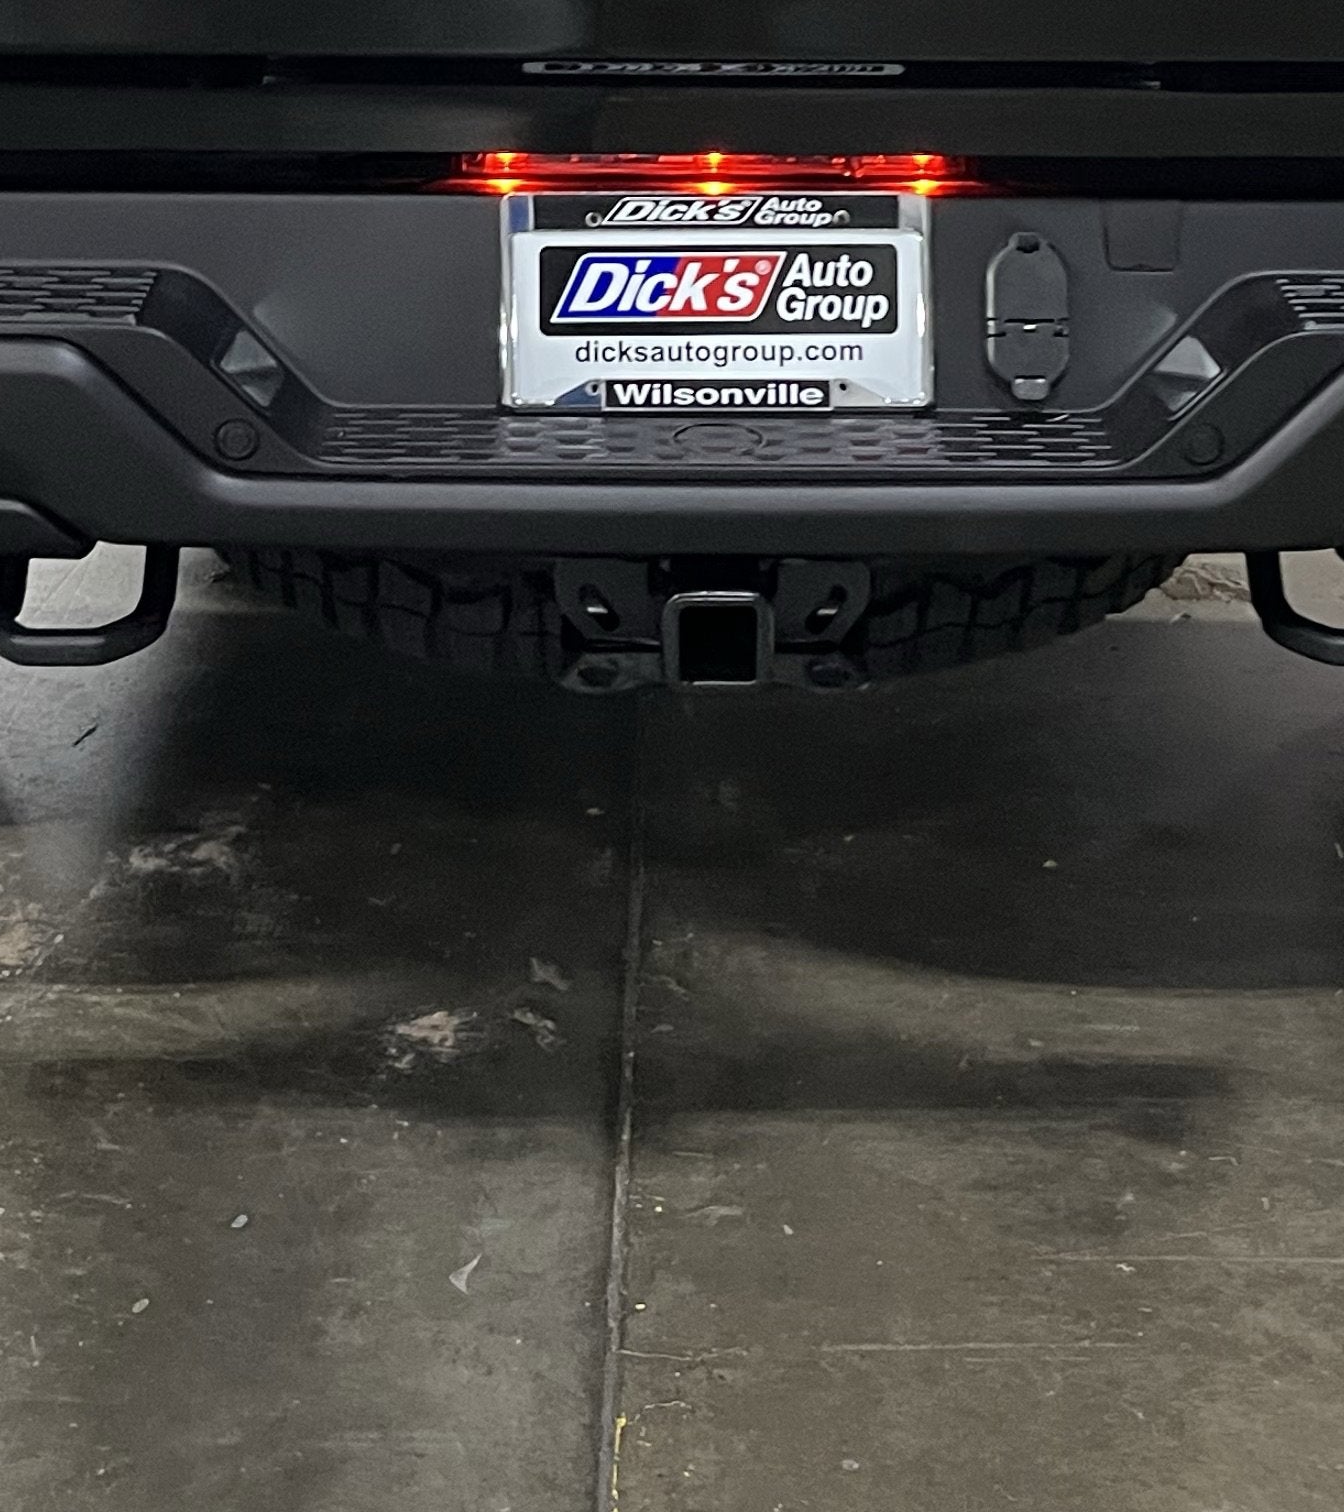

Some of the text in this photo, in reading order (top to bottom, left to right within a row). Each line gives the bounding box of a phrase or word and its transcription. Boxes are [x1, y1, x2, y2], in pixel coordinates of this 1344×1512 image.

[763, 196, 822, 213] Auto
[754, 210, 833, 228] Group
[782, 252, 874, 288] Auto
[568, 258, 759, 313] Dick's
[775, 287, 890, 330] Group
[575, 340, 864, 368] dicksautogroup.com
[612, 382, 825, 407] Wilsonville
